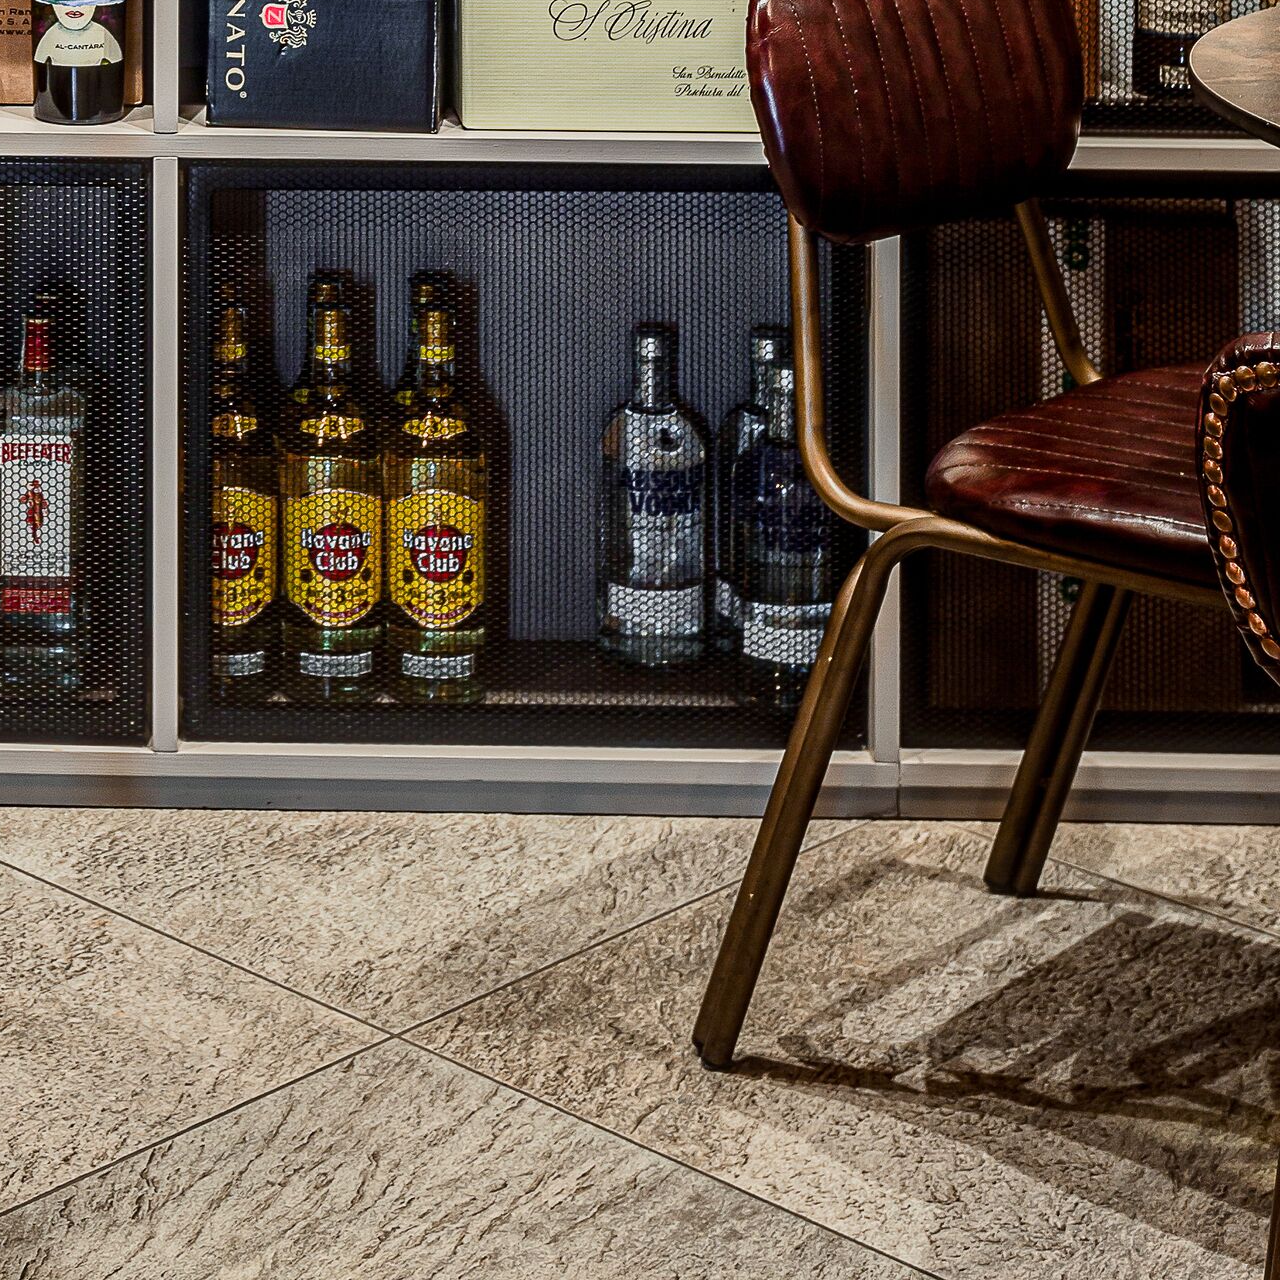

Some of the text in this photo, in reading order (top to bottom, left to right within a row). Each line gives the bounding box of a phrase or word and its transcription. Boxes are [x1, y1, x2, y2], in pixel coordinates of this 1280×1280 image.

[604, 0, 713, 44] Cristina
[672, 65, 746, 79] San Benedetto
[674, 83, 743, 97] Peschiera del
[301, 529, 371, 549] Havana
[316, 552, 359, 571] Club
